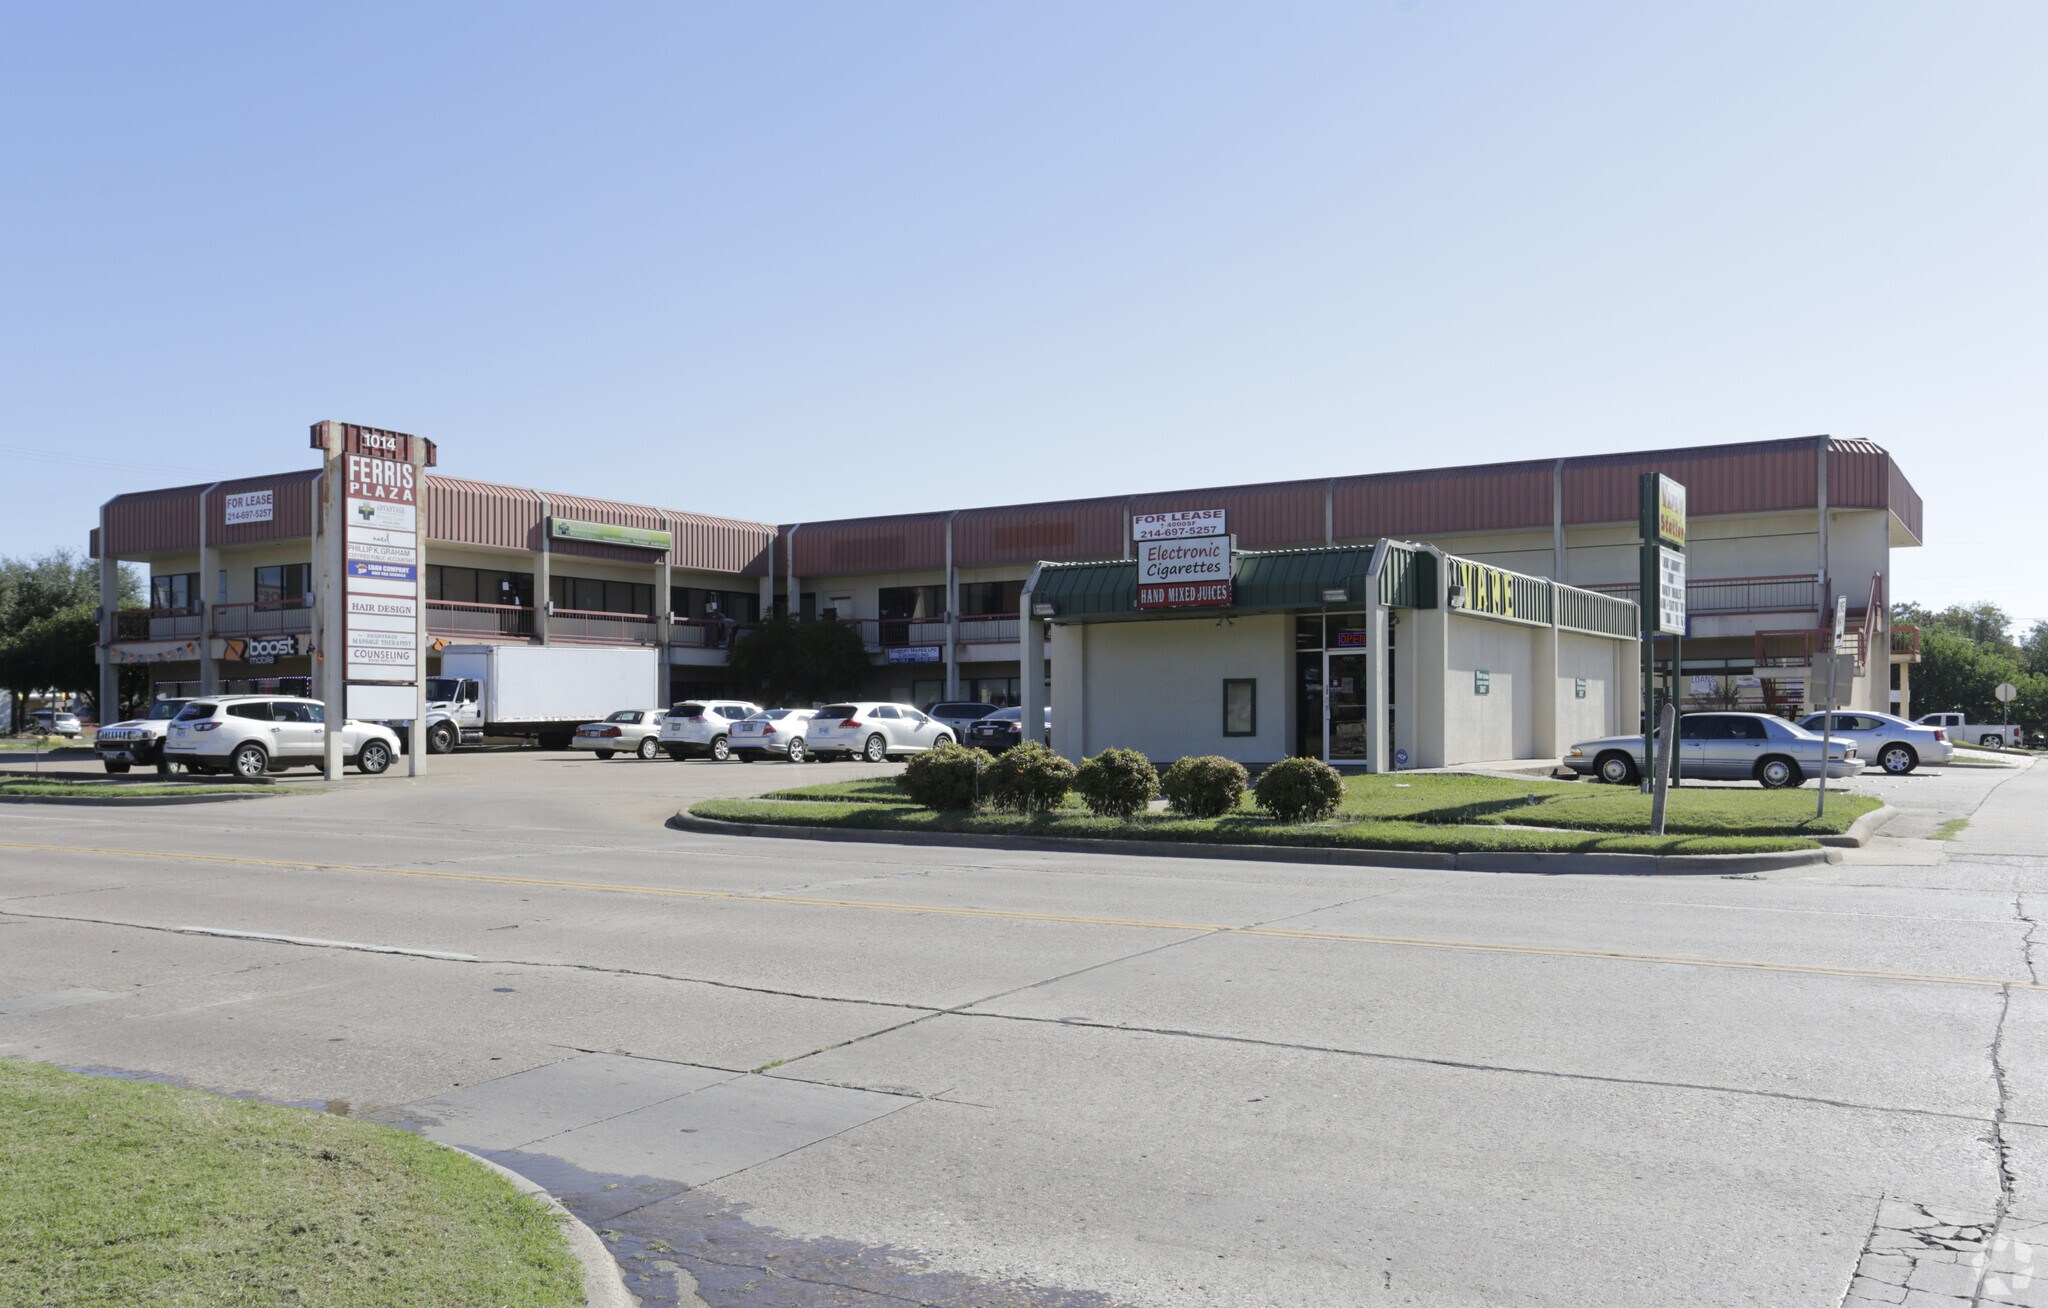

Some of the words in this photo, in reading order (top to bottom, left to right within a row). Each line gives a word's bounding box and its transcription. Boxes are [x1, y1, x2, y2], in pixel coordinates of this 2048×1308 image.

[364, 434, 396, 450] 1014
[350, 455, 414, 489] FERRIS
[350, 482, 413, 501] PLAZA
[227, 498, 243, 509] FOR
[245, 494, 272, 507] LEASE
[227, 509, 272, 521] 214-697-5257
[1135, 514, 1166, 525] FOR
[1171, 510, 1223, 521] LEASE
[1166, 520, 1197, 528] 4000SF
[1140, 526, 1217, 539] 214-697-5257
[348, 545, 373, 553] PHILLIP
[380, 547, 411, 557] GRAHAM
[1147, 542, 1220, 561] Electronic
[368, 564, 382, 572] LOAN
[382, 565, 410, 574] COMPANY
[1147, 561, 1221, 580] Cigarettes
[1141, 588, 1165, 604] HAND
[1168, 586, 1196, 602] MIXED
[1197, 585, 1227, 601] JUICES
[1461, 561, 1514, 617] VAPE
[352, 602, 376, 612] HAIR
[377, 604, 412, 614] DESIGN
[381, 639, 412, 647] THERAPIST
[1340, 634, 1366, 644] OPEN
[249, 636, 295, 656] boost
[249, 655, 275, 665] mobile
[353, 649, 410, 660] COUNSELING
[1691, 675, 1715, 684] LOANS
